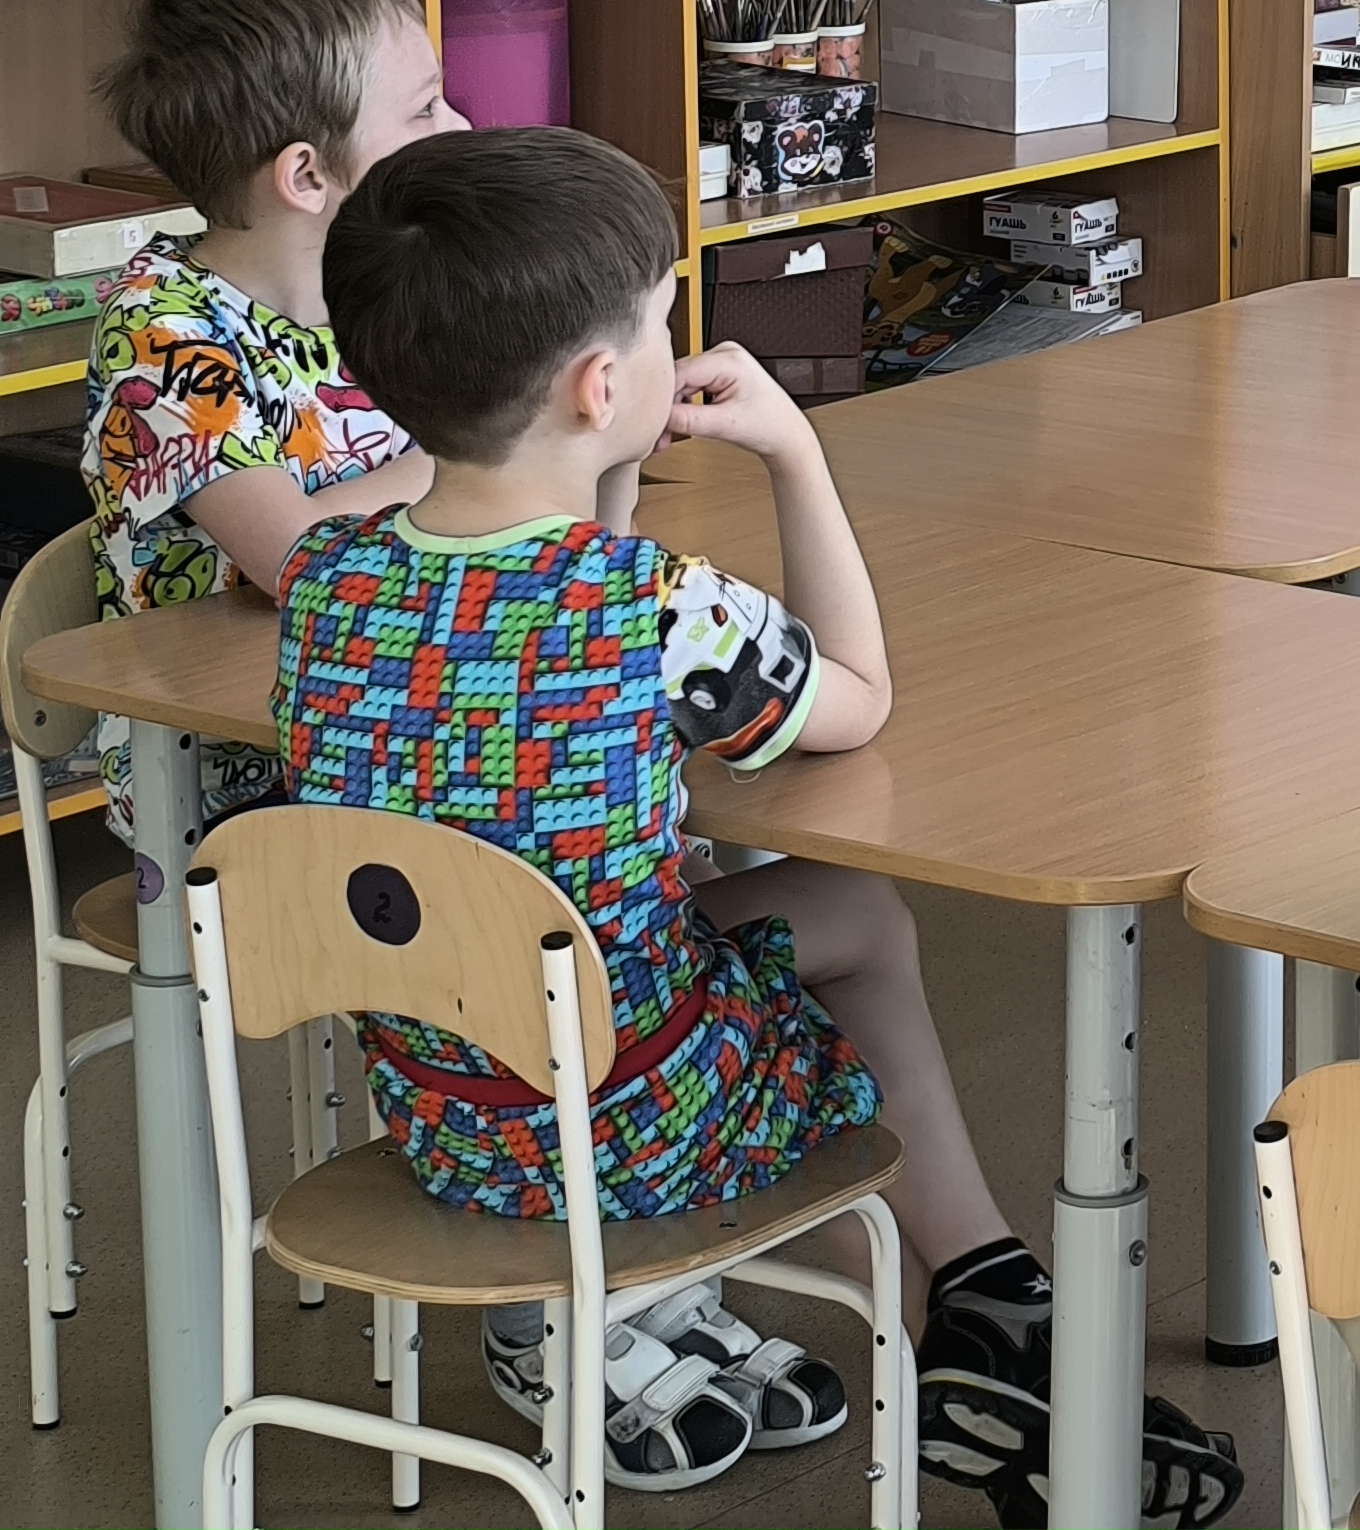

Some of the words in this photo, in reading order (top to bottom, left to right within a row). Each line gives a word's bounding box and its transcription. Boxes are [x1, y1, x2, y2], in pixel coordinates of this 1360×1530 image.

[989, 216, 1027, 230] ГУАШЬ
[1075, 292, 1106, 310] ГУАШЬ
[372, 891, 392, 924] 2
